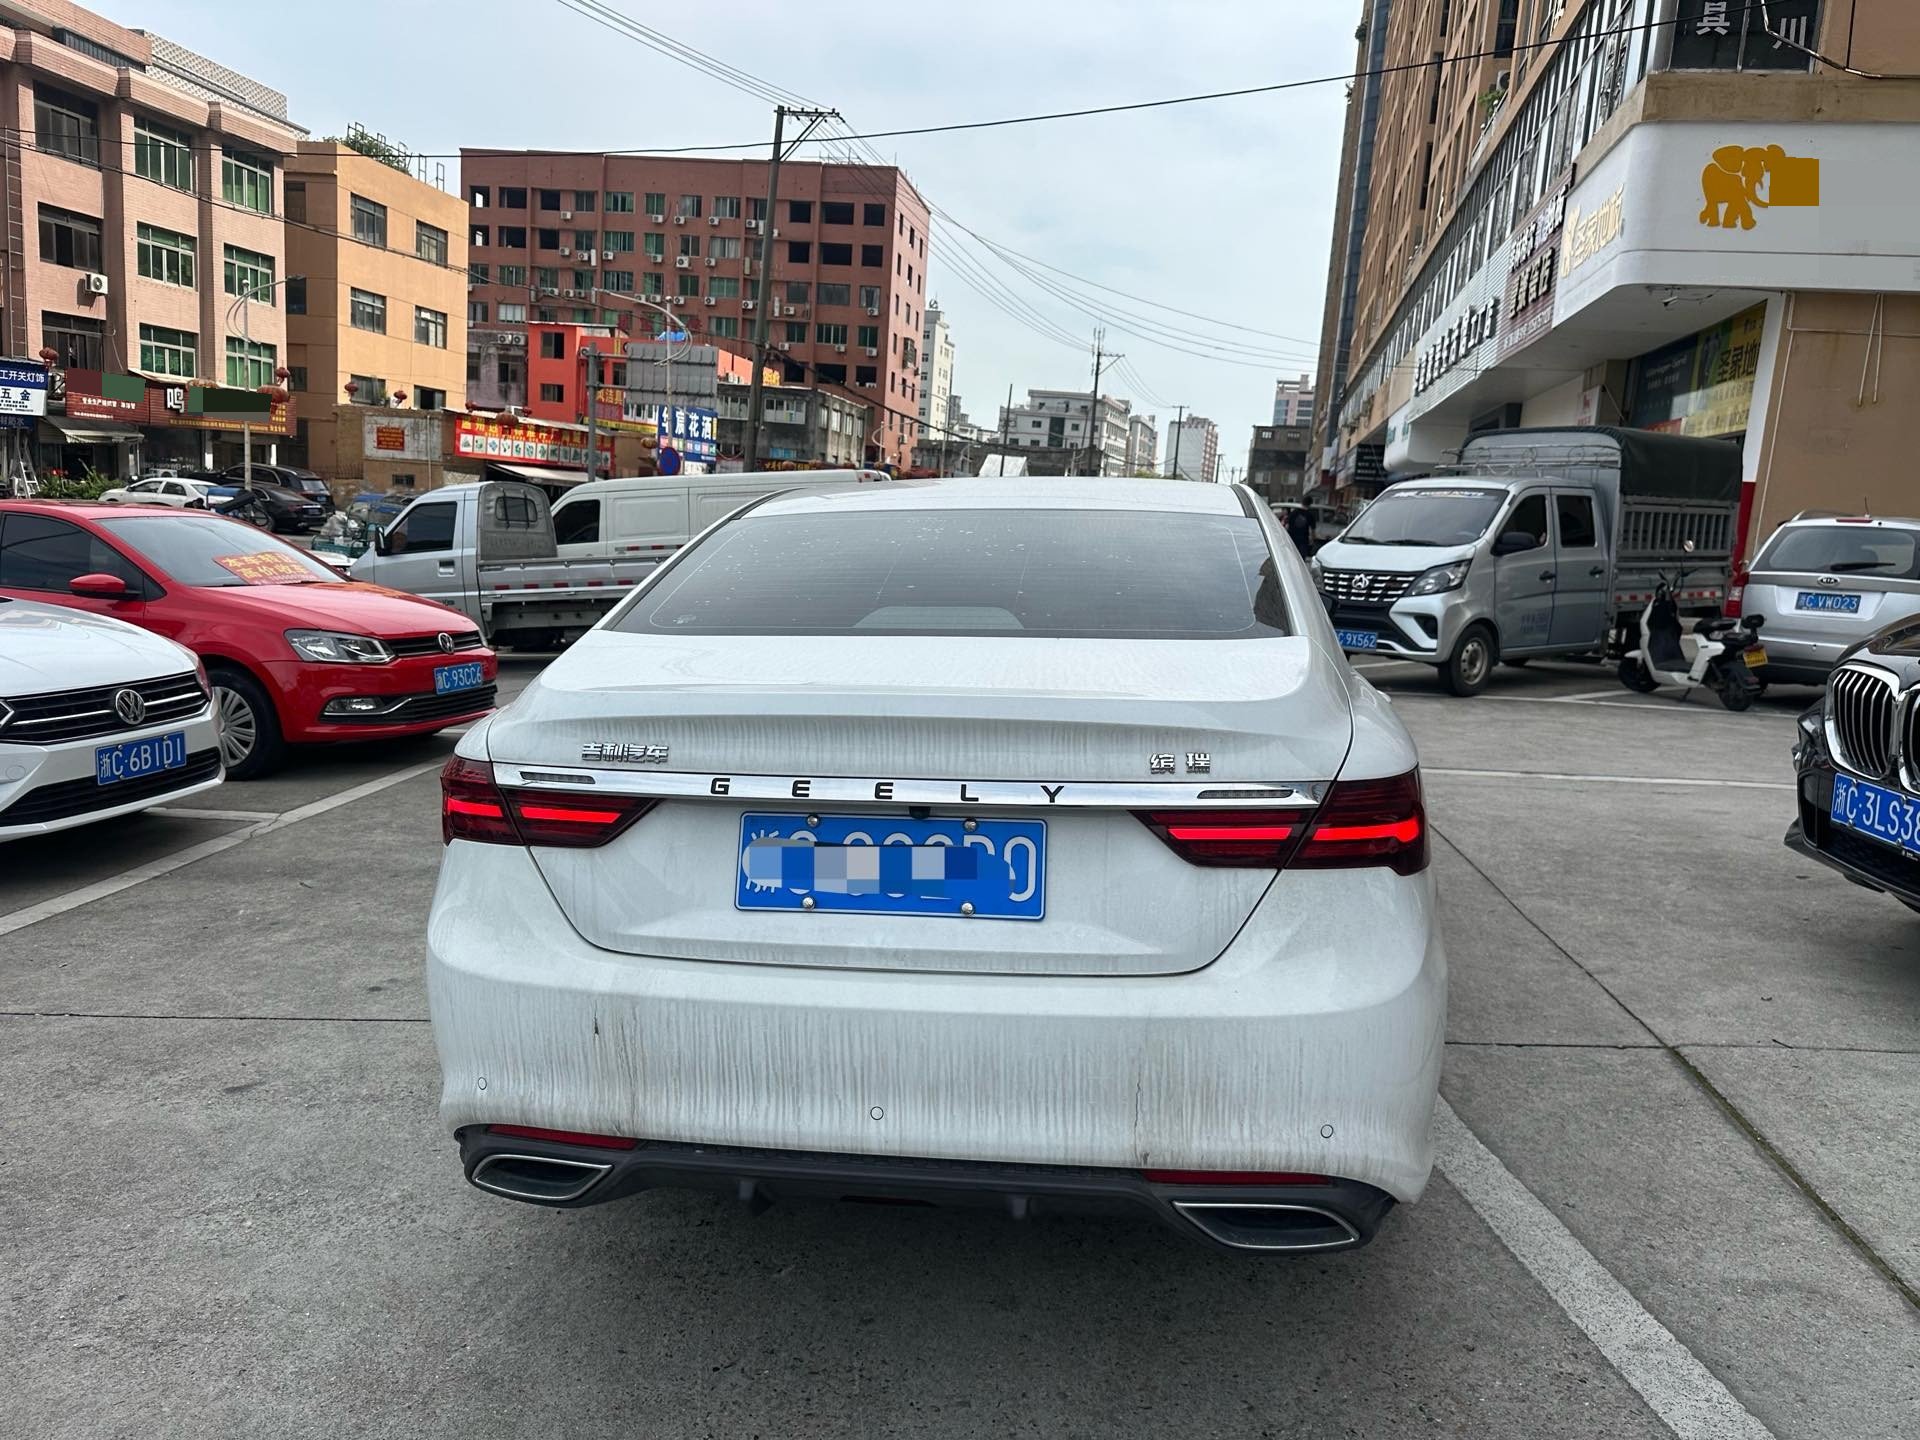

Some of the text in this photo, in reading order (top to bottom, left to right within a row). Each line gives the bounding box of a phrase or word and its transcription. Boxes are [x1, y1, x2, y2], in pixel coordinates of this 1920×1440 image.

[582, 743, 669, 764] 吉利汽车
[710, 777, 1065, 803] GEELY
